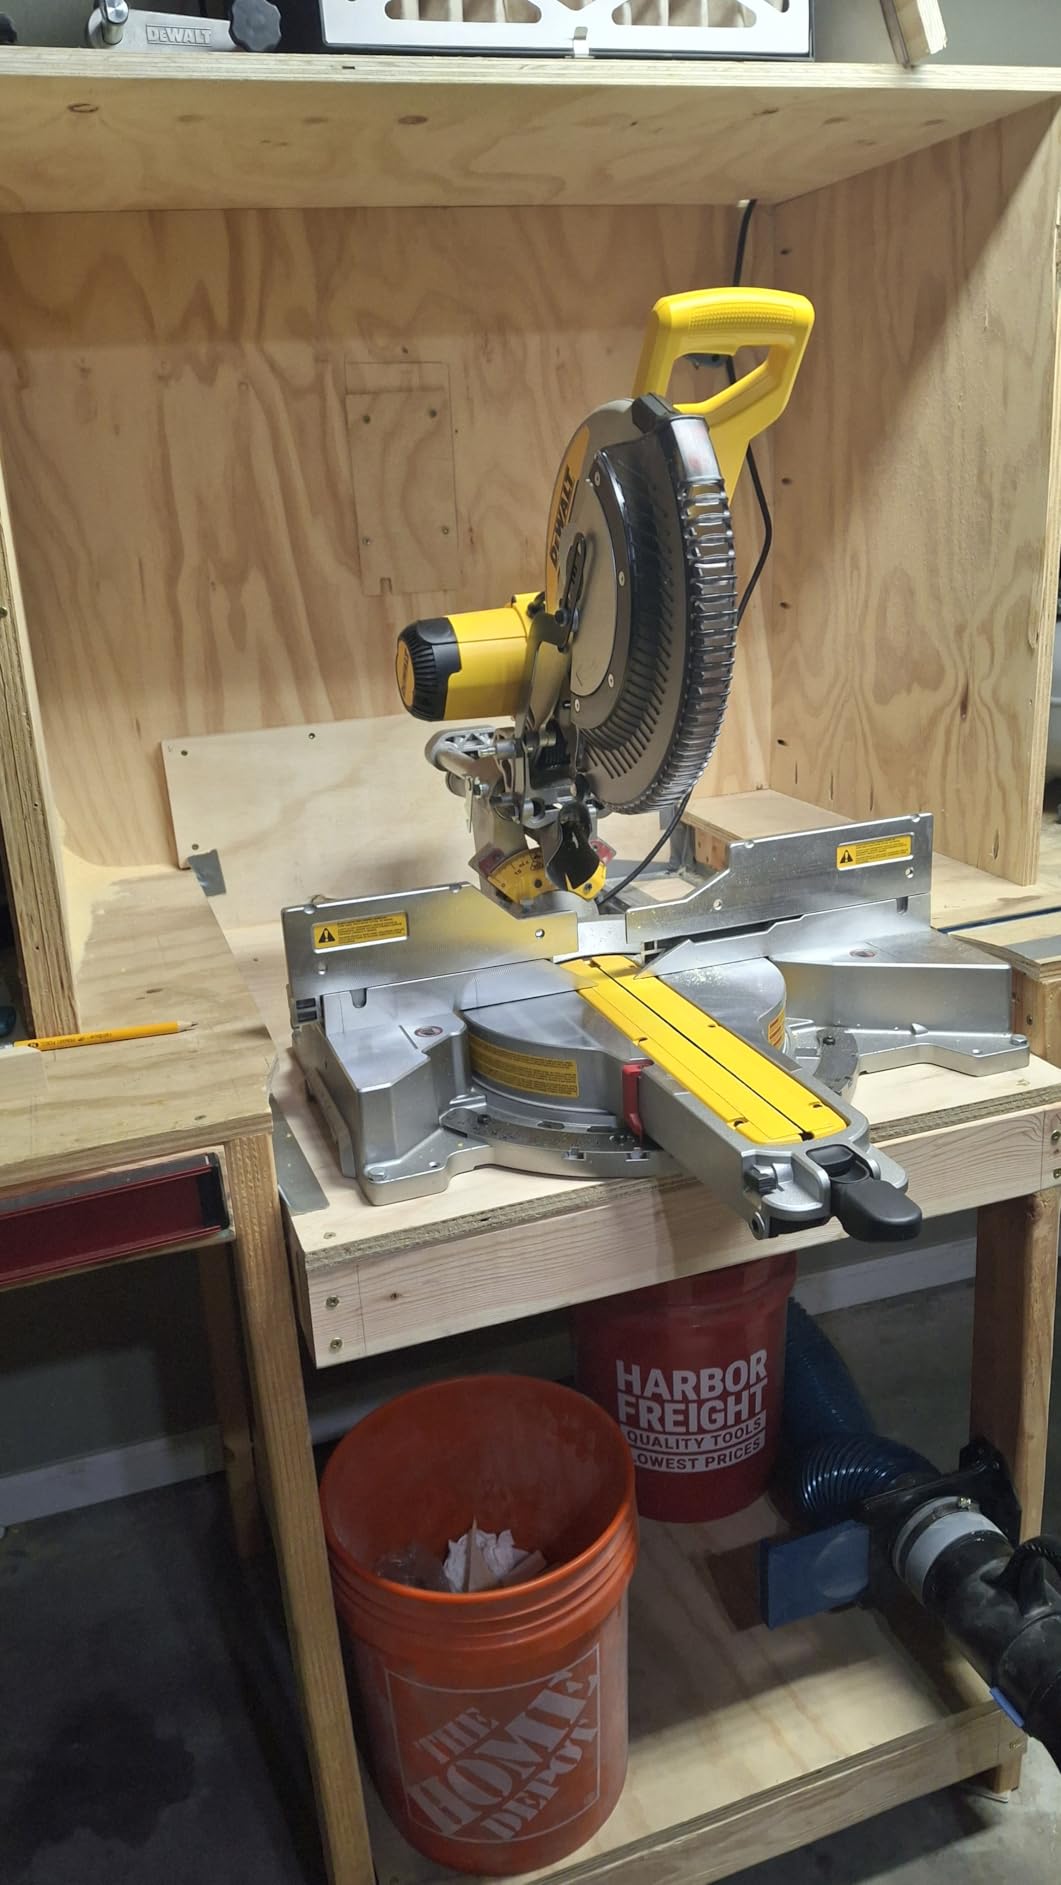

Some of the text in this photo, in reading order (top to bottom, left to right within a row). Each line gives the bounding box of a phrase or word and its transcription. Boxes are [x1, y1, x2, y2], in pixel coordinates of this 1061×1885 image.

[616, 1349, 767, 1400] HARBOR
[617, 1378, 768, 1433] FREIGHT
[627, 1416, 762, 1450] QUALITY TOOLS
[705, 1436, 761, 1468] PRICES
[405, 1670, 598, 1836] HOME
[413, 1707, 499, 1765] THE
[480, 1718, 598, 1840] DEPOT
